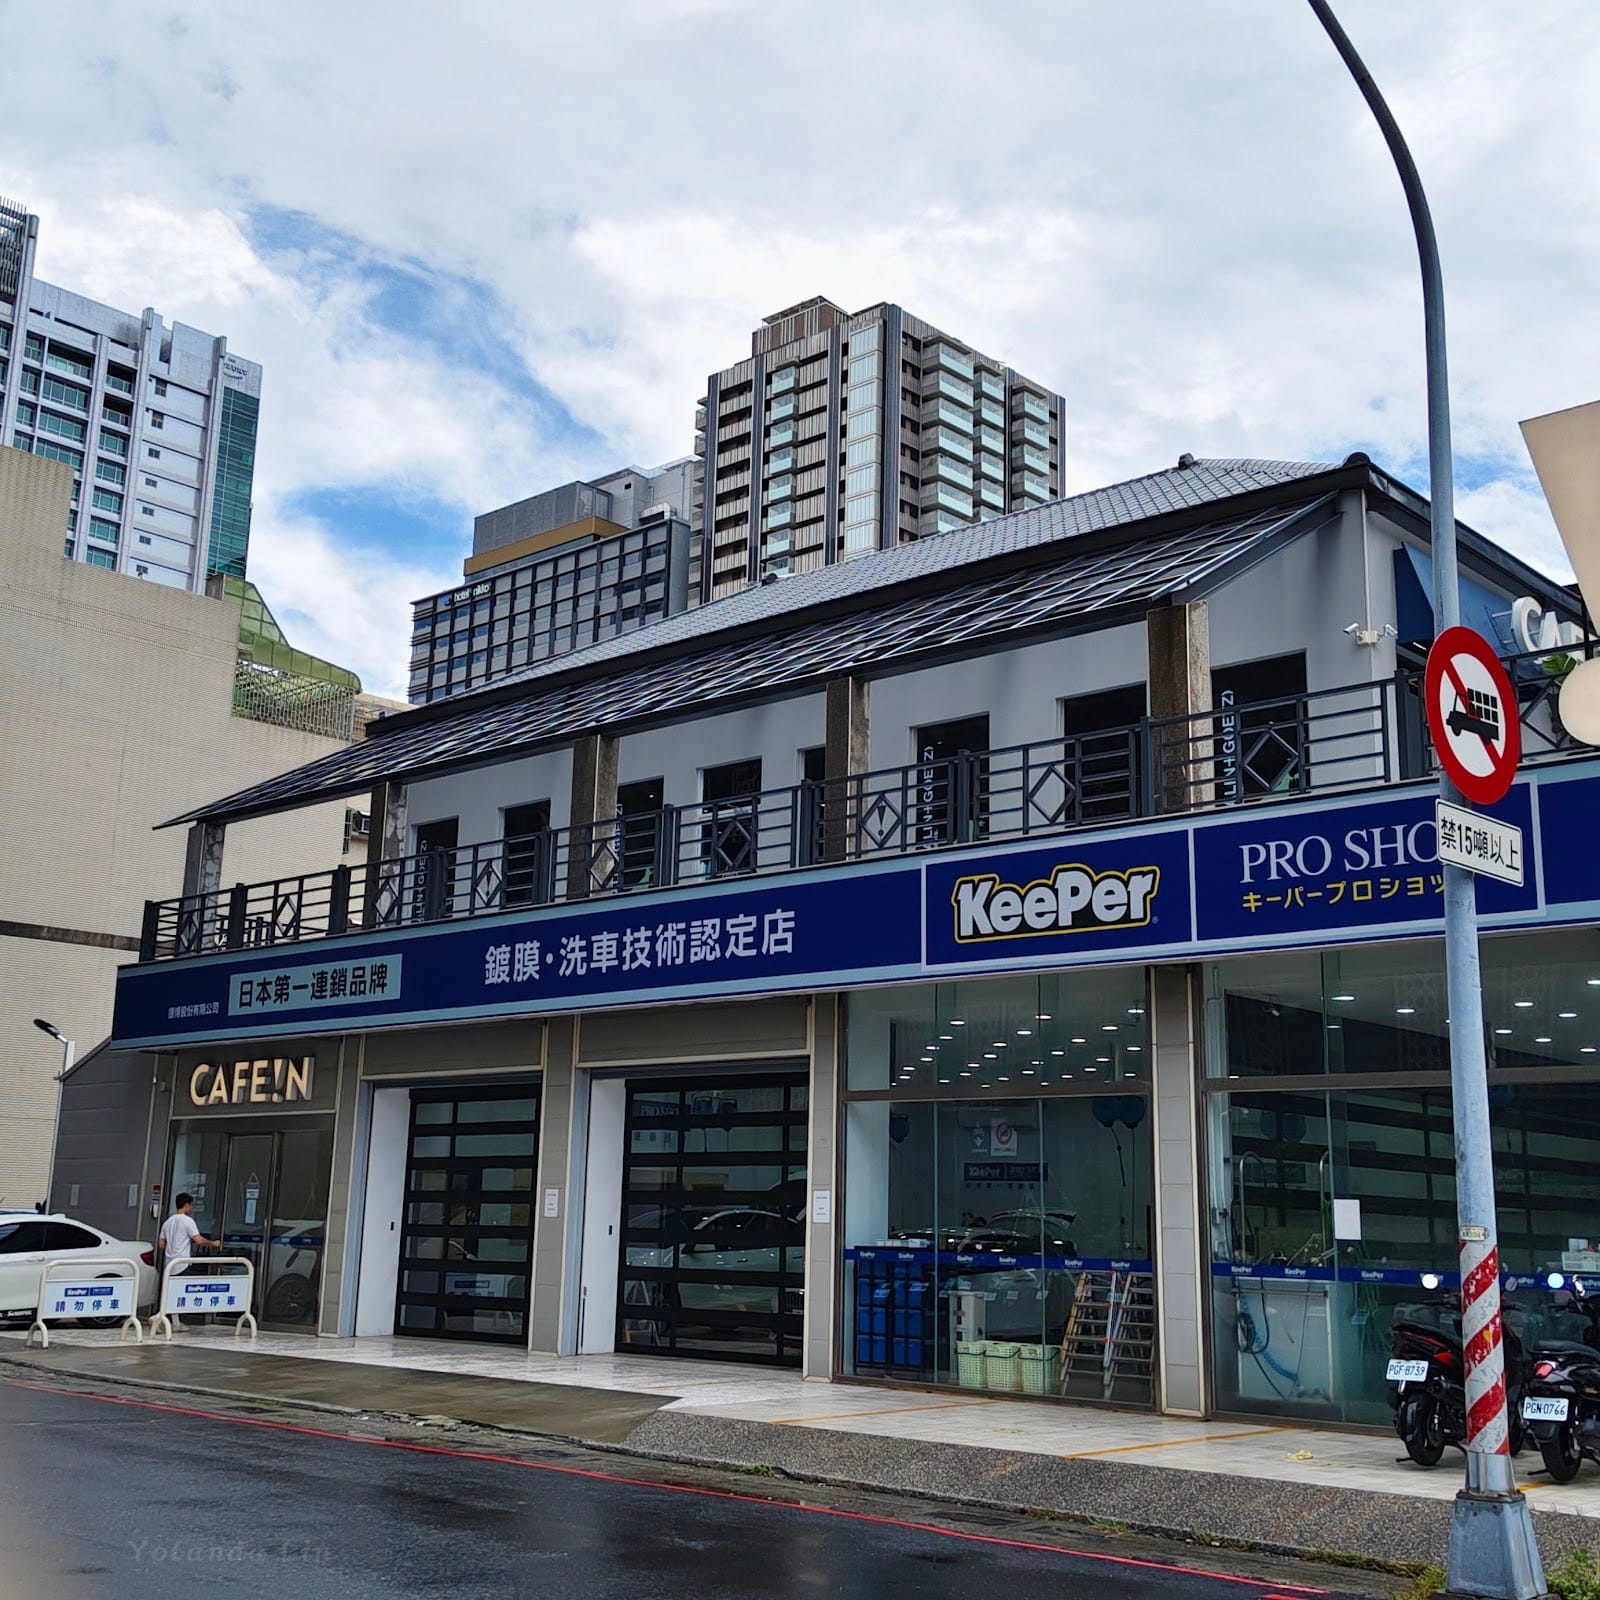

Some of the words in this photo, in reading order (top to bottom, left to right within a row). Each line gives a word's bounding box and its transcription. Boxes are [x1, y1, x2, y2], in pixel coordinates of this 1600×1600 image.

[1238, 834, 1332, 884] PRO
[1344, 820, 1438, 873] SHO
[1440, 816, 1520, 873] 禁15噸以上
[953, 866, 1158, 940] KeePer
[1241, 874, 1444, 913] キーパープロショッ
[238, 963, 389, 1010] 日本第一連鎖品牌
[188, 1056, 315, 1107] CAFE!N
